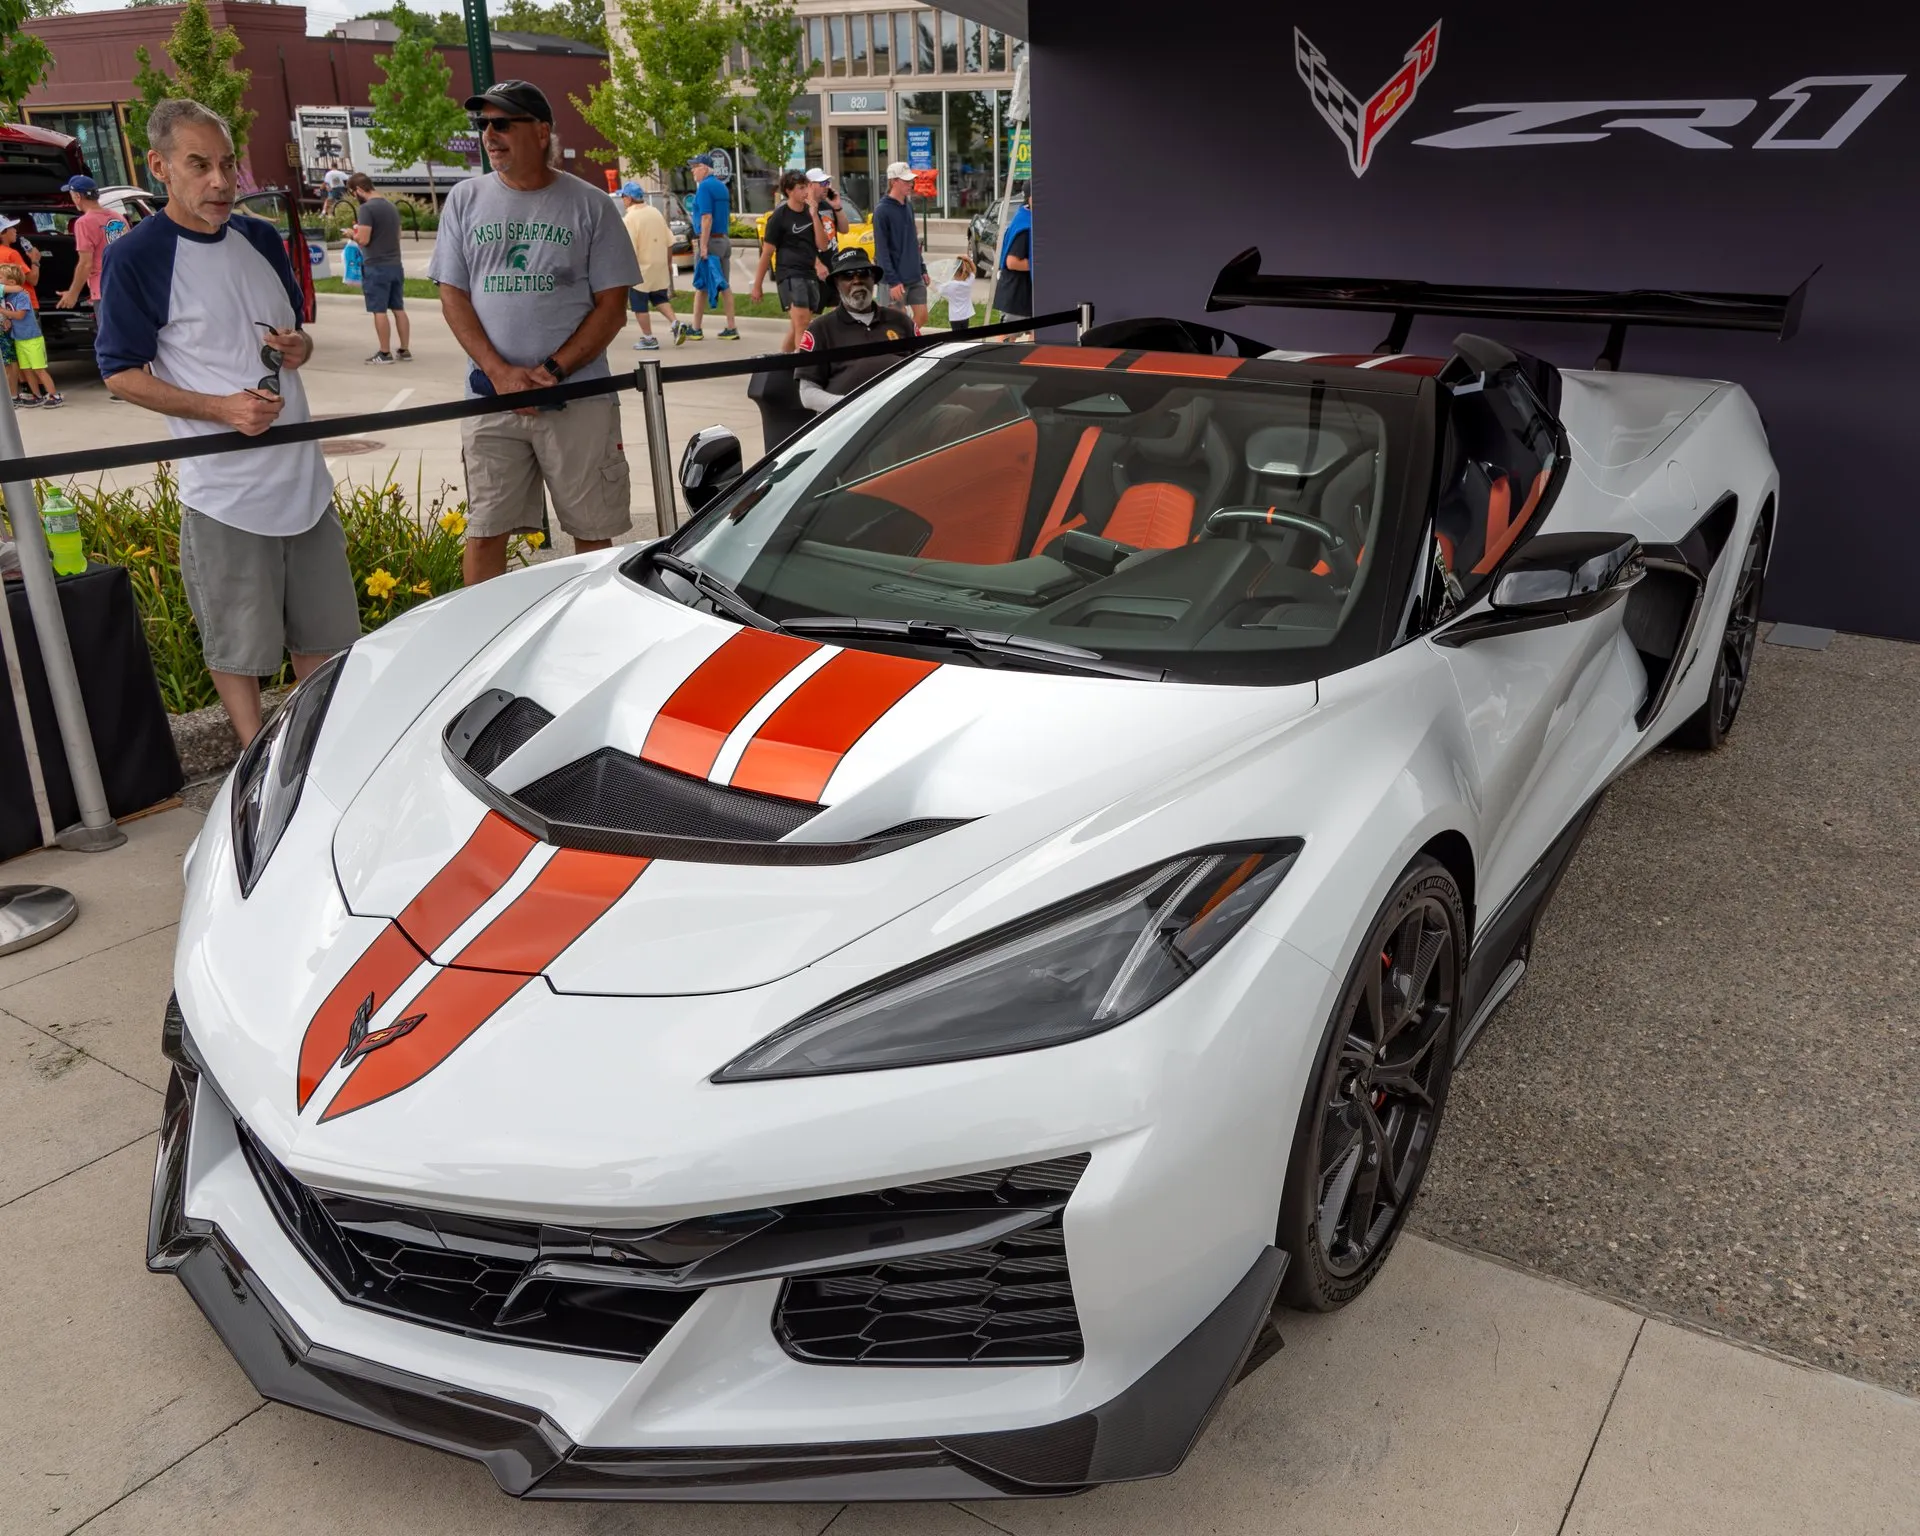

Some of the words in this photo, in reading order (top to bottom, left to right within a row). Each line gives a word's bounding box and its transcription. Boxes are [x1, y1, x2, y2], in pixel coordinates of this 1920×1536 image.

[850, 96, 868, 109] 820
[354, 116, 371, 126] FINE
[1411, 74, 1907, 150] ZR1
[474, 222, 502, 246] MSU
[508, 222, 573, 246] SPARTANS
[838, 250, 857, 261] SECURITY
[483, 274, 554, 292] ATHLETICS
[1425, 876, 1454, 897] MICHELIN
